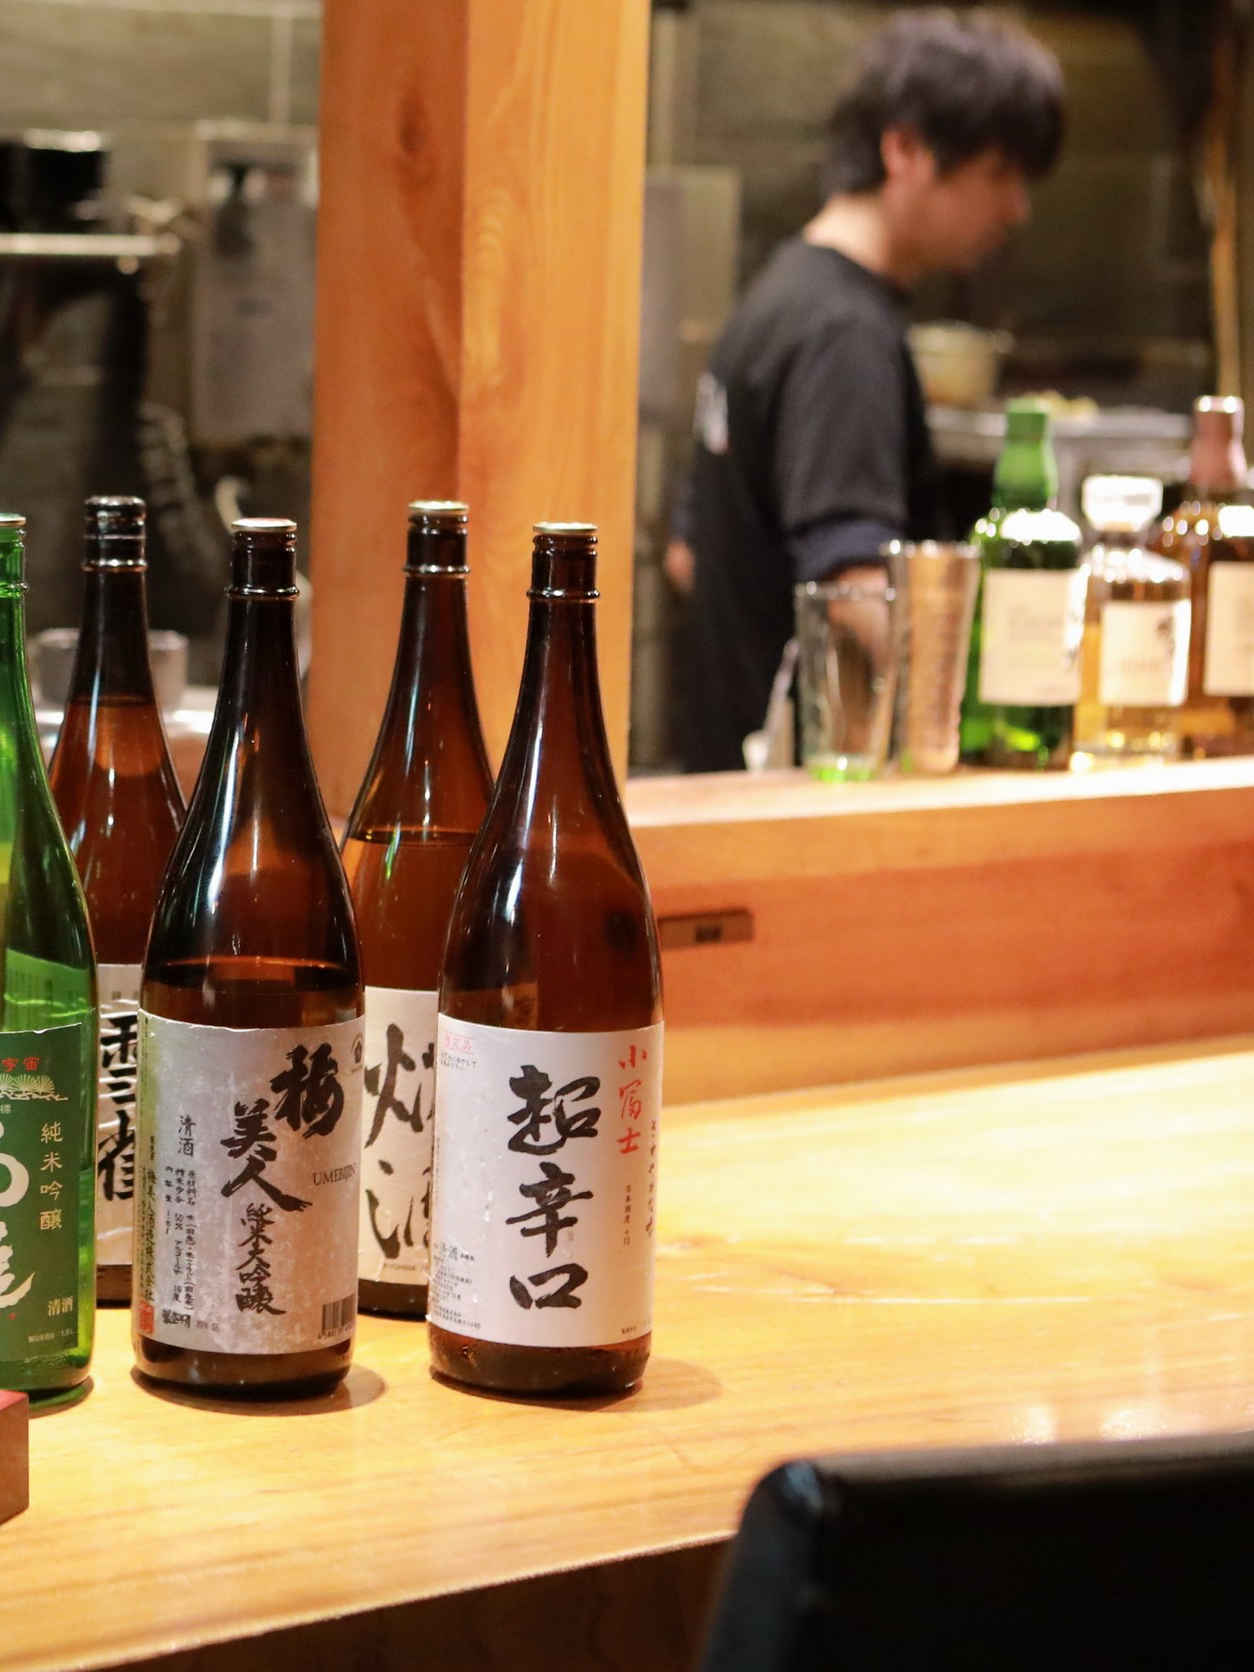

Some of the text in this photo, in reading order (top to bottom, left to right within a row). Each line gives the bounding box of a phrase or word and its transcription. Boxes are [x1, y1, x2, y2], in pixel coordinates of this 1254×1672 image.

[40, 1121, 64, 1231] 純米吟醸
[178, 1115, 196, 1157] 清酒
[506, 1065, 602, 1310] 超辛口
